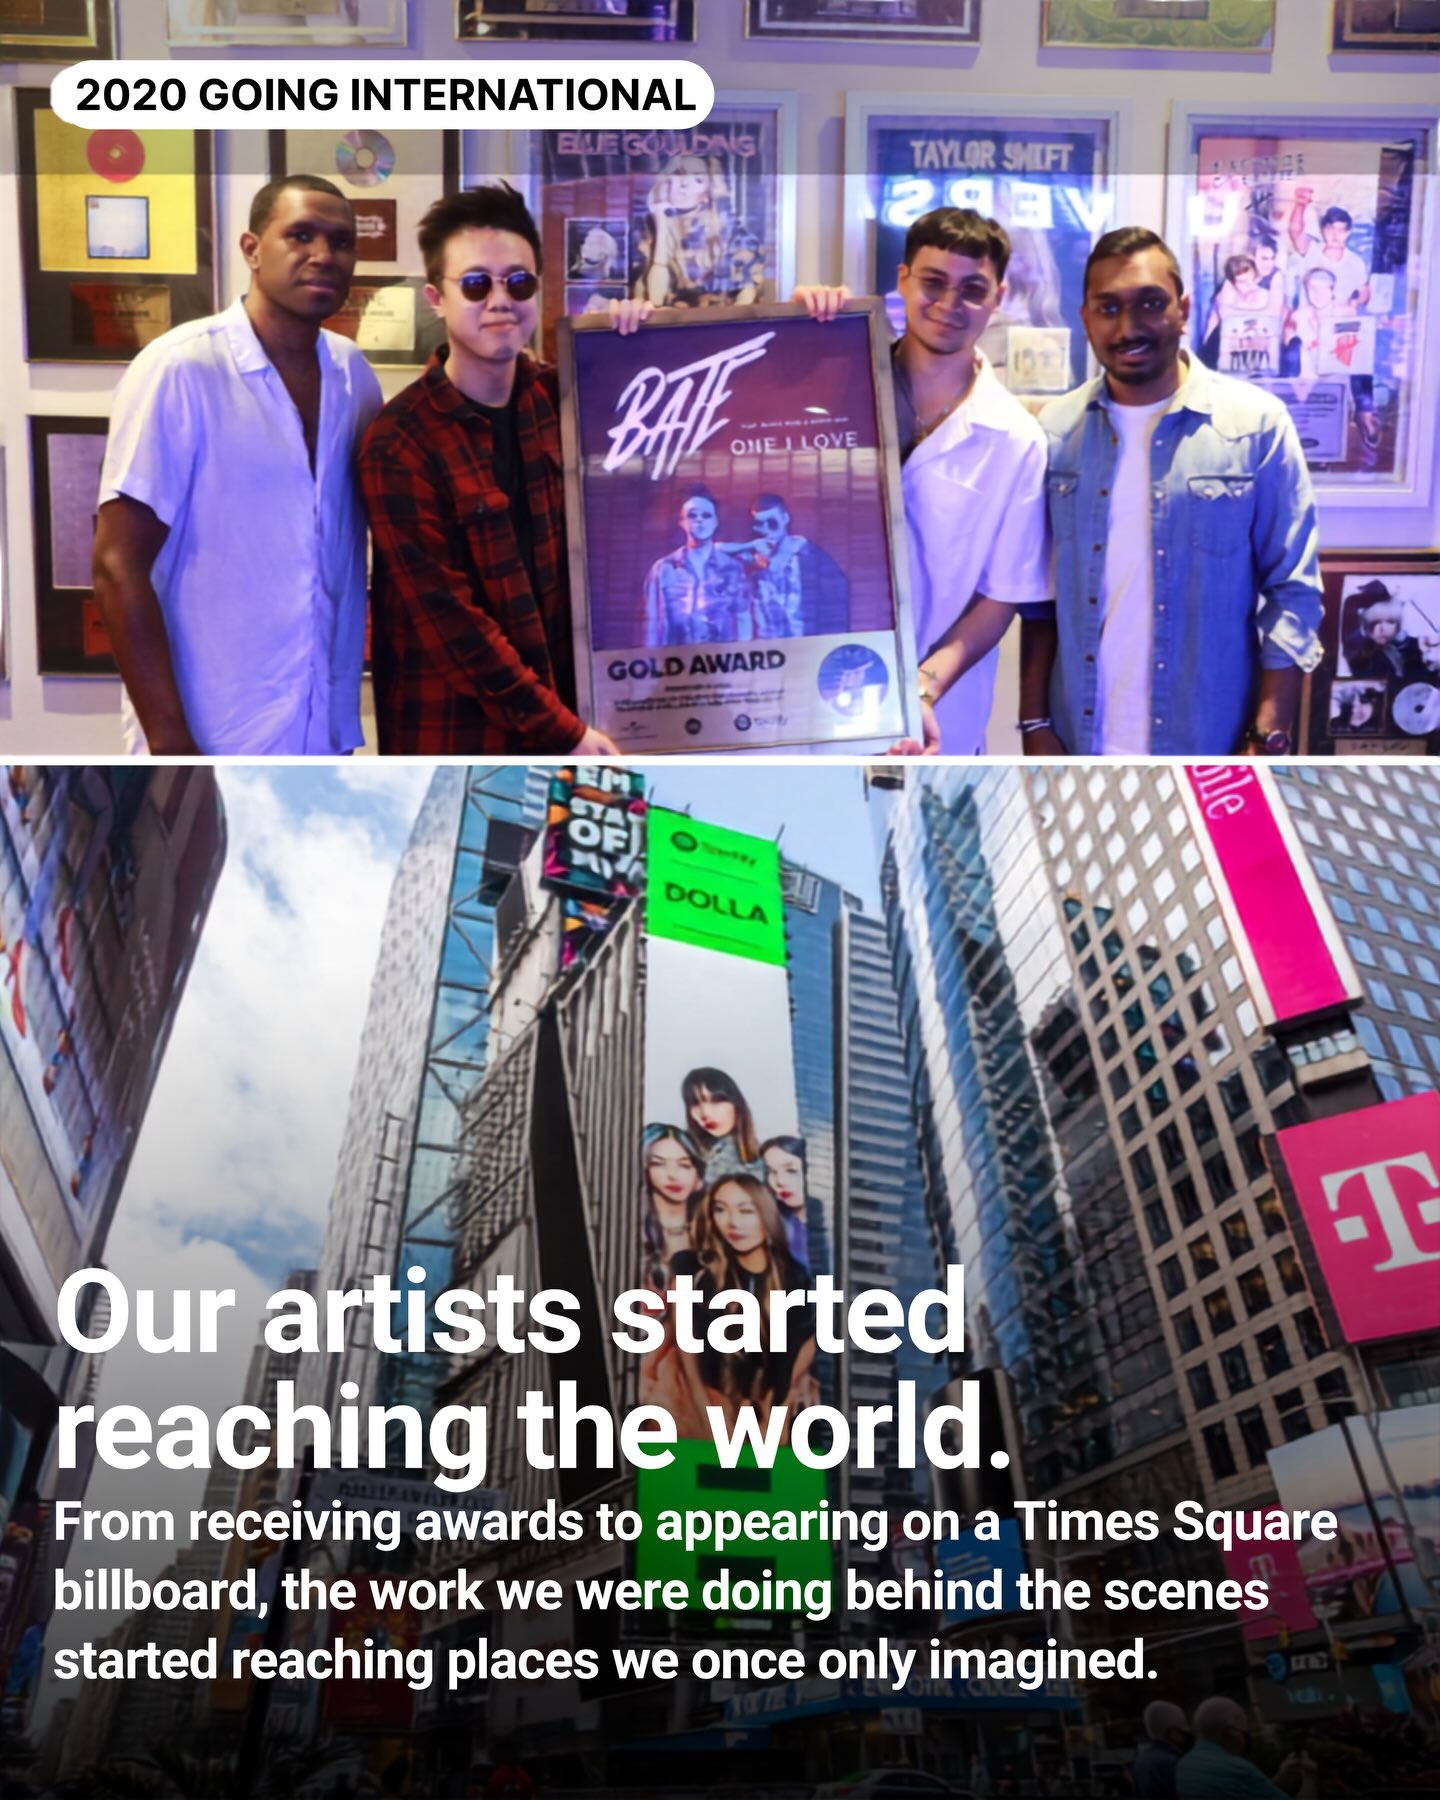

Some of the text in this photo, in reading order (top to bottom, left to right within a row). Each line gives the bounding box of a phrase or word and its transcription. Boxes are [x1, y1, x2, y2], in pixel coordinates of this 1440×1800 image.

[910, 140, 1074, 172] TAYLOR SWIFT
[800, 431, 858, 451] LOVE
[607, 650, 786, 681] GOLD AWARD
[568, 818, 629, 855] OF
[664, 882, 769, 925] DOLLA
